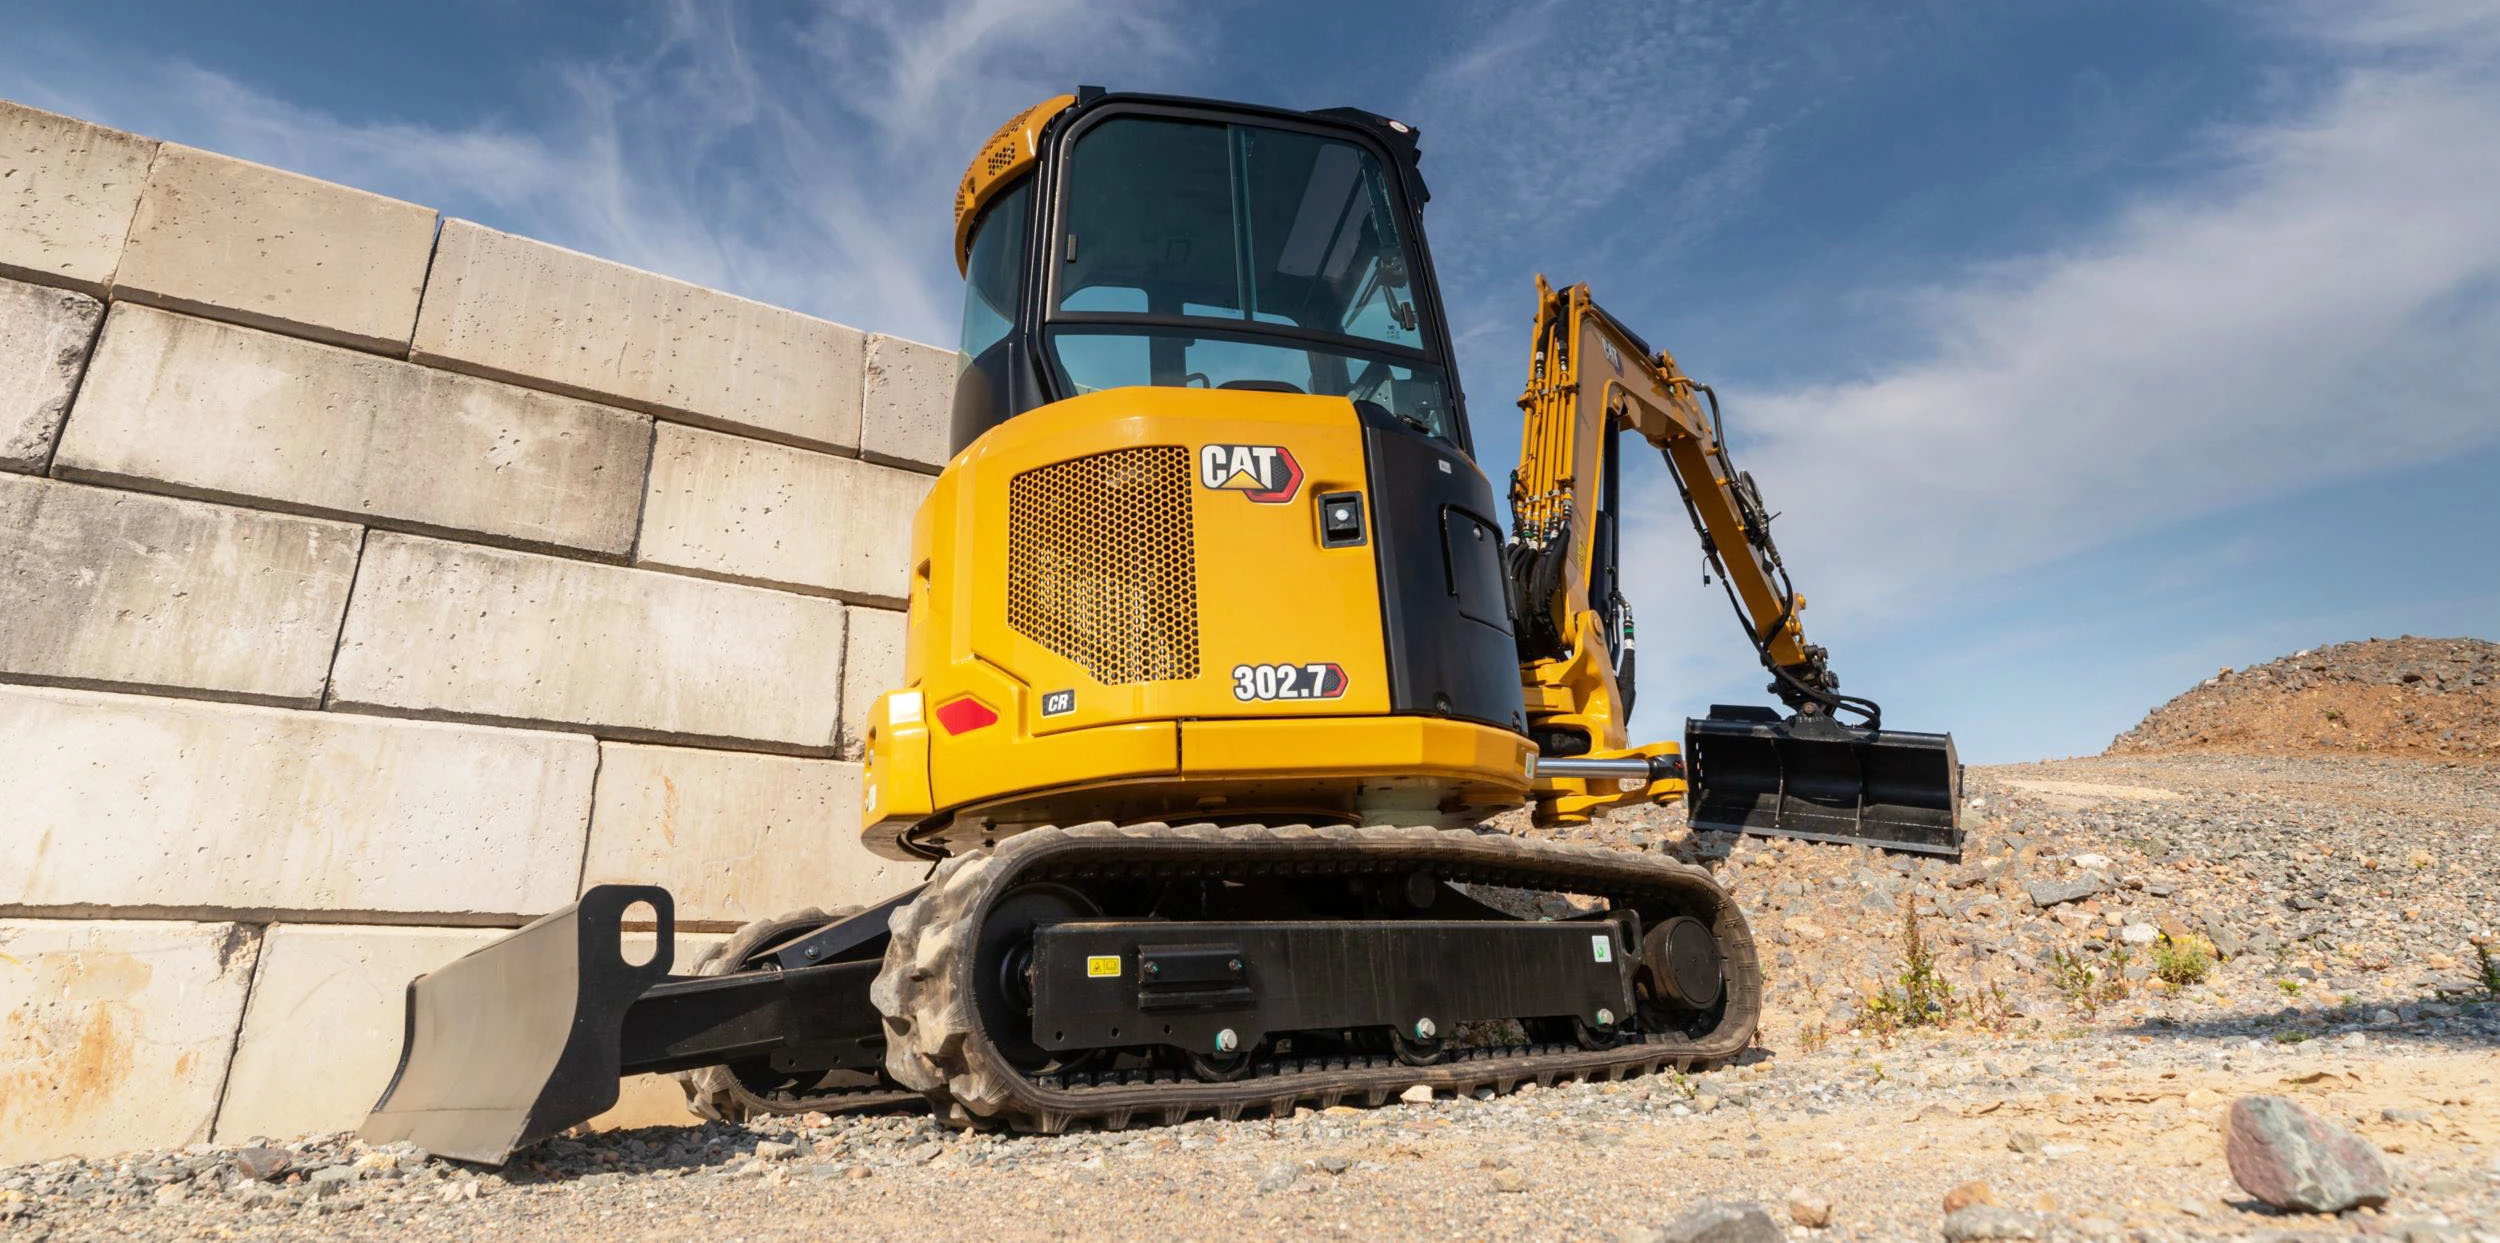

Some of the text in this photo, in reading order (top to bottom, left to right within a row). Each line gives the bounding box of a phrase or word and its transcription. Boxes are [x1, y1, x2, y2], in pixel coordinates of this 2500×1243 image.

[1601, 336, 1620, 369] CAT
[1201, 445, 1277, 489] CAT
[1234, 664, 1326, 700] 302.7
[1048, 694, 1069, 712] CR
